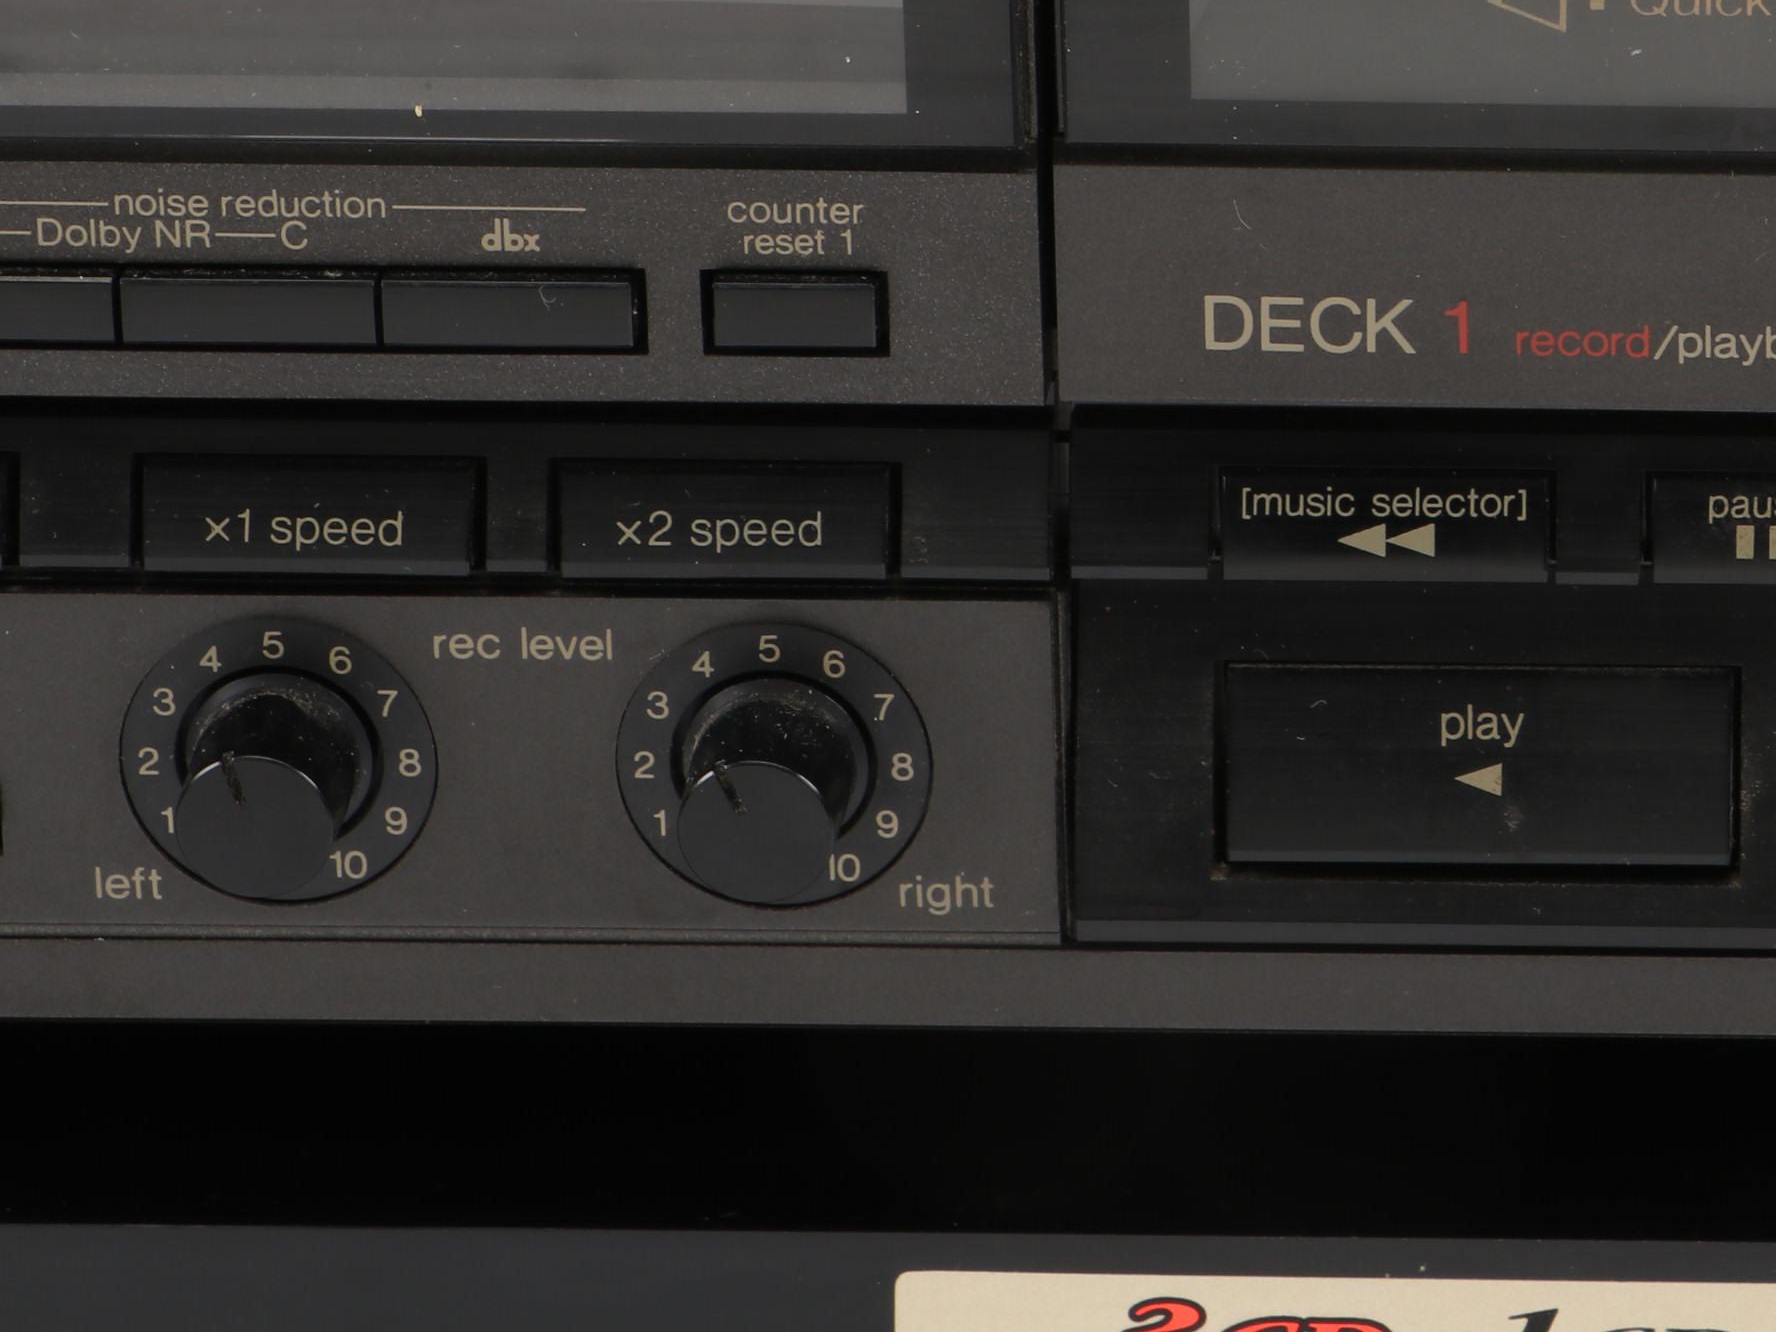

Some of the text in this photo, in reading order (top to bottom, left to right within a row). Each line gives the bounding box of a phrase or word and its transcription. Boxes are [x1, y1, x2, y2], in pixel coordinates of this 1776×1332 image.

[114, 187, 386, 219] noise reduction
[727, 197, 865, 225] counter
[36, 217, 308, 251] Dolby NR C
[480, 217, 541, 252] dbx
[743, 228, 852, 256] reset 1
[1203, 294, 1417, 354] DECK
[1445, 300, 1469, 354] 1
[1241, 486, 1527, 521] [music selector]
[270, 510, 404, 552] speed
[616, 510, 822, 554] x2 speed
[199, 645, 222, 673] 4
[262, 630, 285, 659] 5
[433, 627, 614, 661] rec level
[758, 634, 781, 663] 5
[329, 645, 353, 675] 6
[691, 650, 715, 678] 4
[823, 649, 846, 679] 6
[152, 687, 176, 716] 3
[377, 689, 399, 718] 7
[646, 690, 670, 720] 3
[873, 693, 895, 721] 7
[1440, 703, 1525, 748] play
[138, 747, 160, 776] 2
[398, 748, 422, 777] 8
[634, 750, 655, 779] 2
[891, 752, 914, 781] 8
[160, 806, 175, 834] 1
[384, 806, 408, 836] 9
[653, 809, 667, 837] 1
[875, 809, 899, 839] 9
[329, 850, 368, 879] 10
[827, 852, 862, 883] 10
[95, 866, 163, 900] left
[899, 875, 994, 916] right
